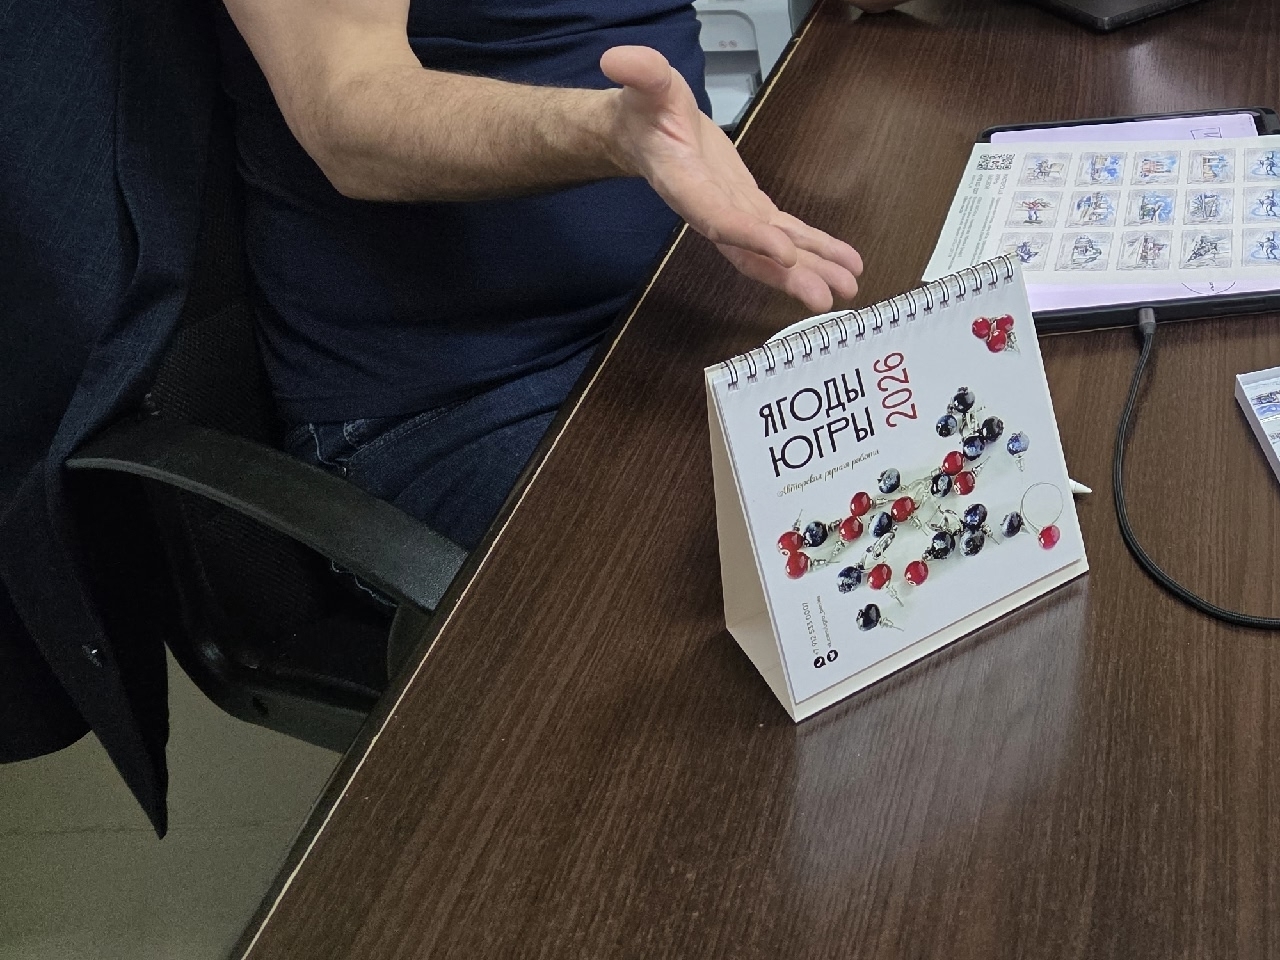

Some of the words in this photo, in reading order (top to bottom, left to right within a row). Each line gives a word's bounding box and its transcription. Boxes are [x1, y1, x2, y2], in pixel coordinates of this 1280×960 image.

[758, 368, 866, 437] ЯГОДЫ
[873, 352, 917, 427] 2026
[768, 406, 875, 477] ЮГРЫ
[777, 472, 823, 497] Авторская
[824, 462, 850, 482] ручная
[850, 449, 880, 470] работа
